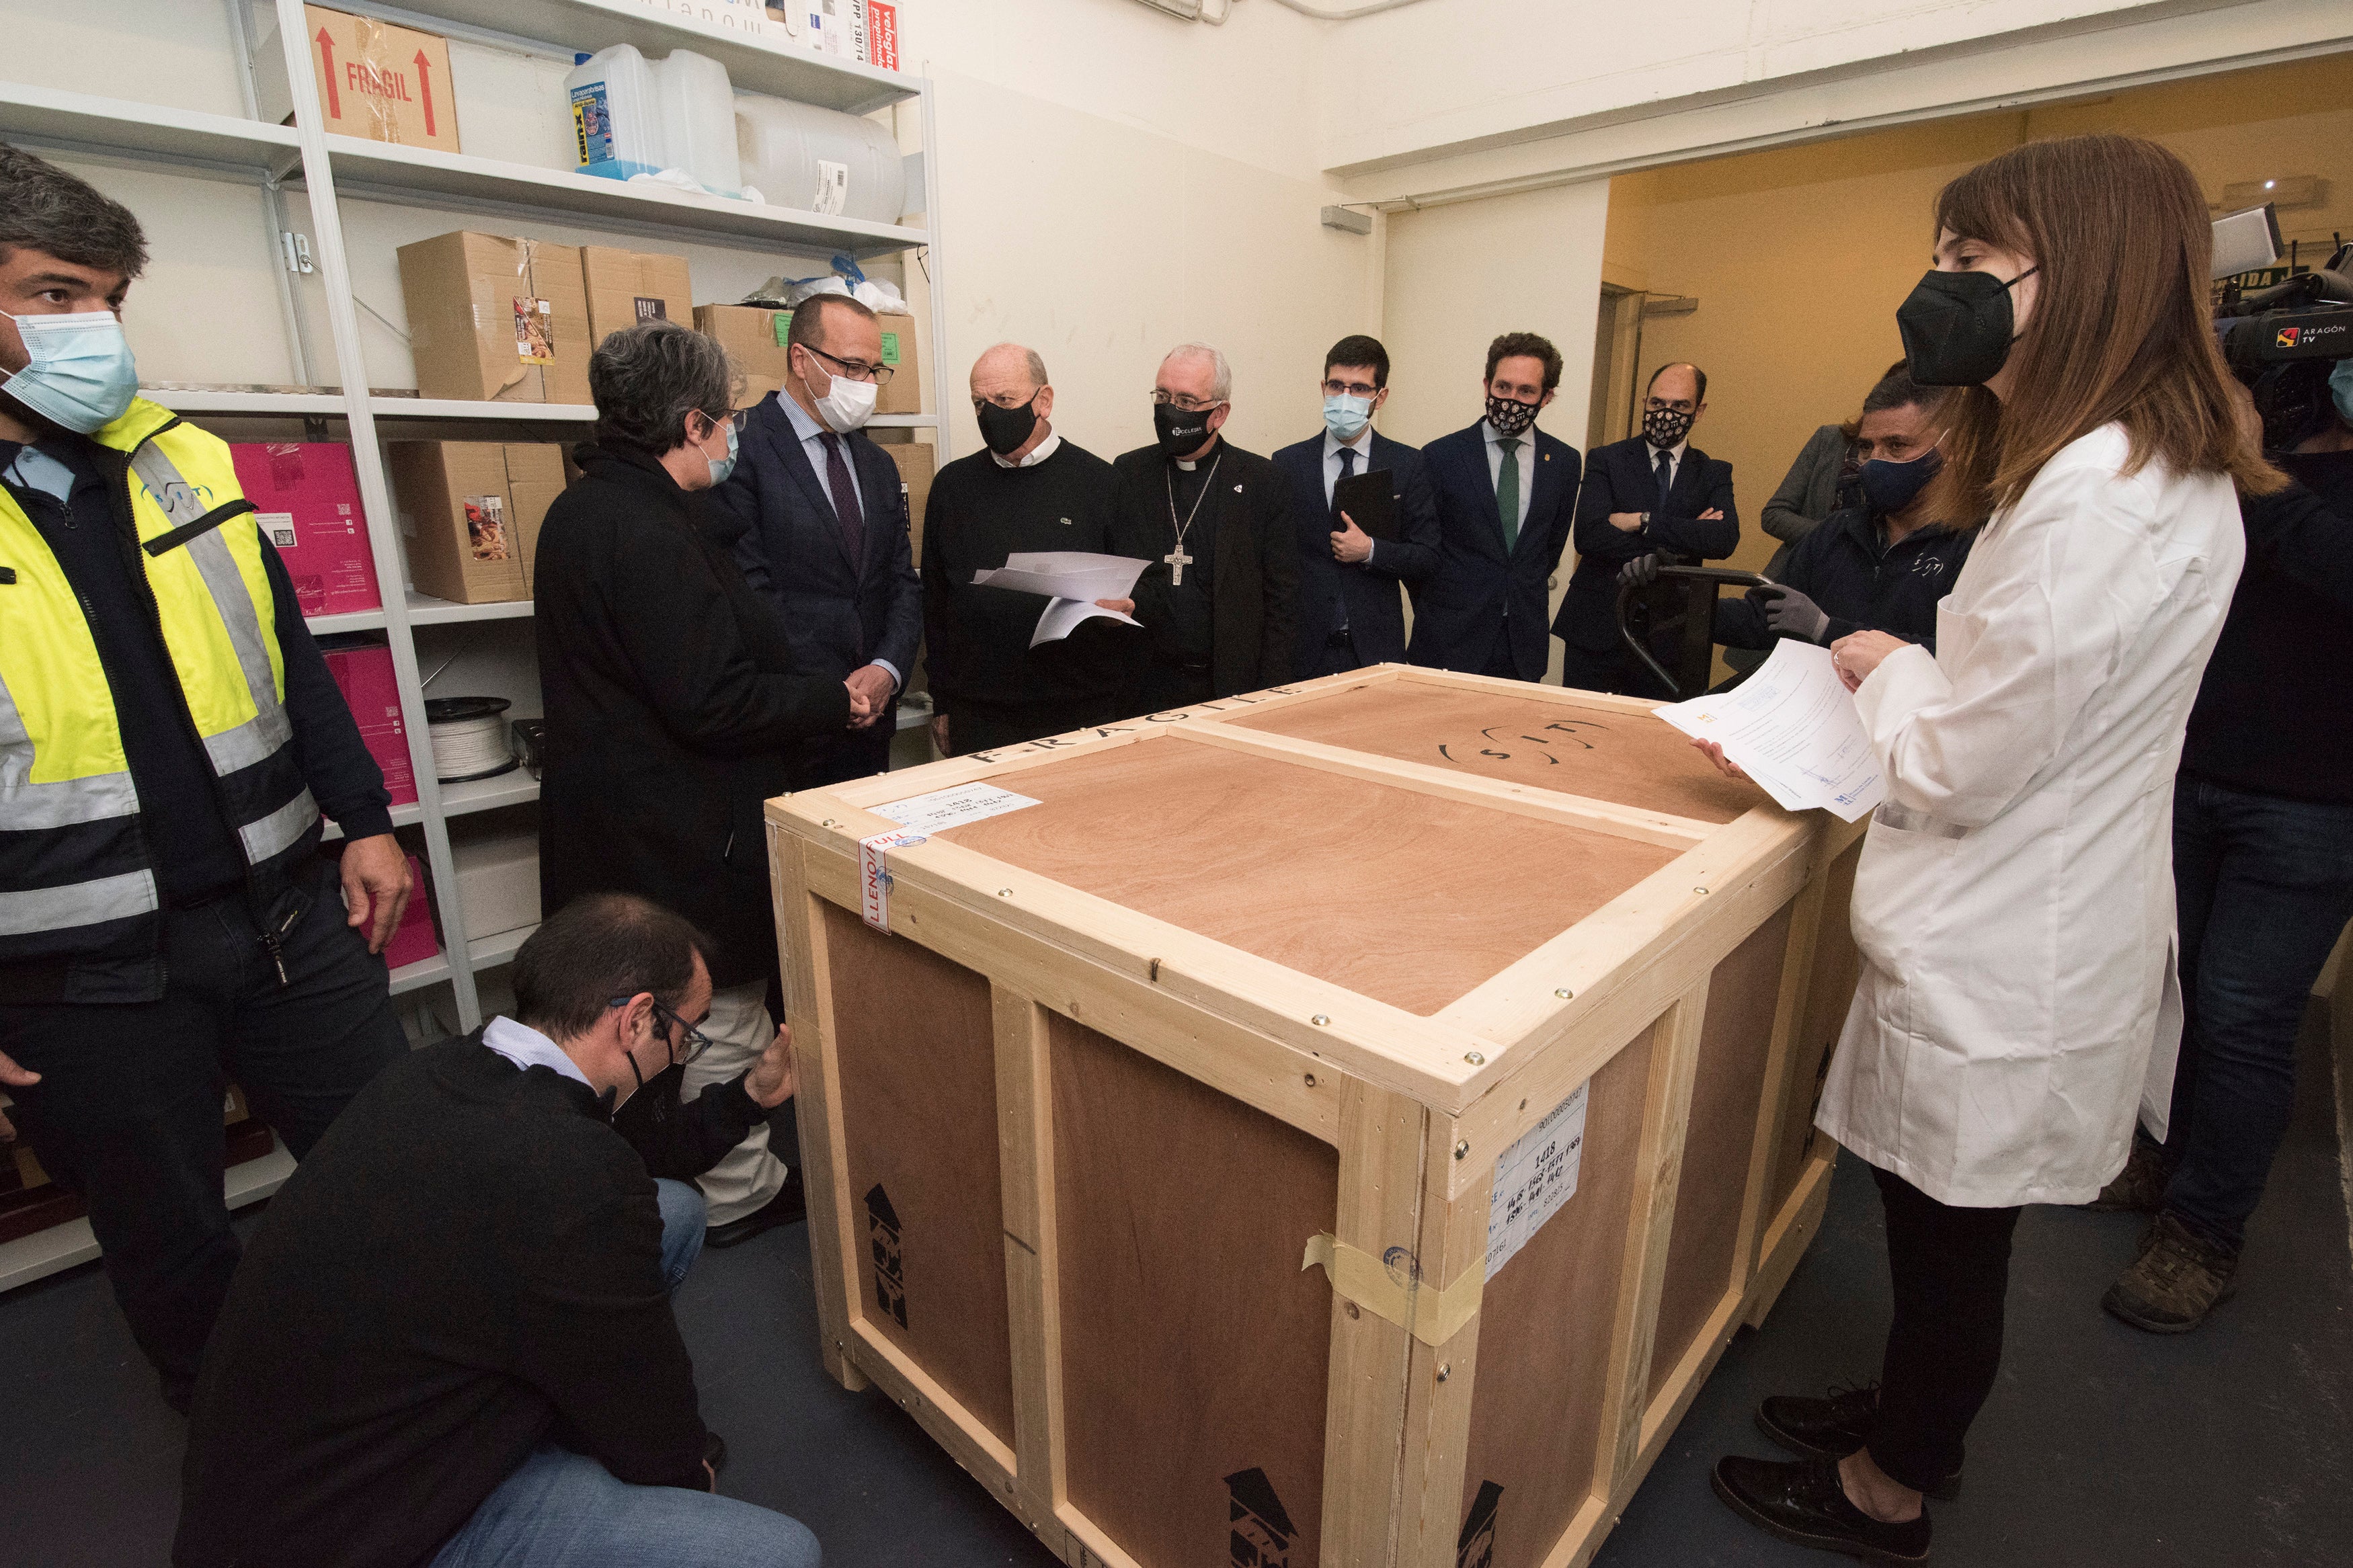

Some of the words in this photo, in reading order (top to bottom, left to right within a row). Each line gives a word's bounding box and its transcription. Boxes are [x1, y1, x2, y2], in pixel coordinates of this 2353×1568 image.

[854, 24, 864, 61] 130/14
[346, 62, 412, 102] FRAGIL
[2303, 325, 2346, 335] ARAGÓN
[967, 687, 1302, 764] FRAGILE
[1535, 1141, 1556, 1169] 1418
